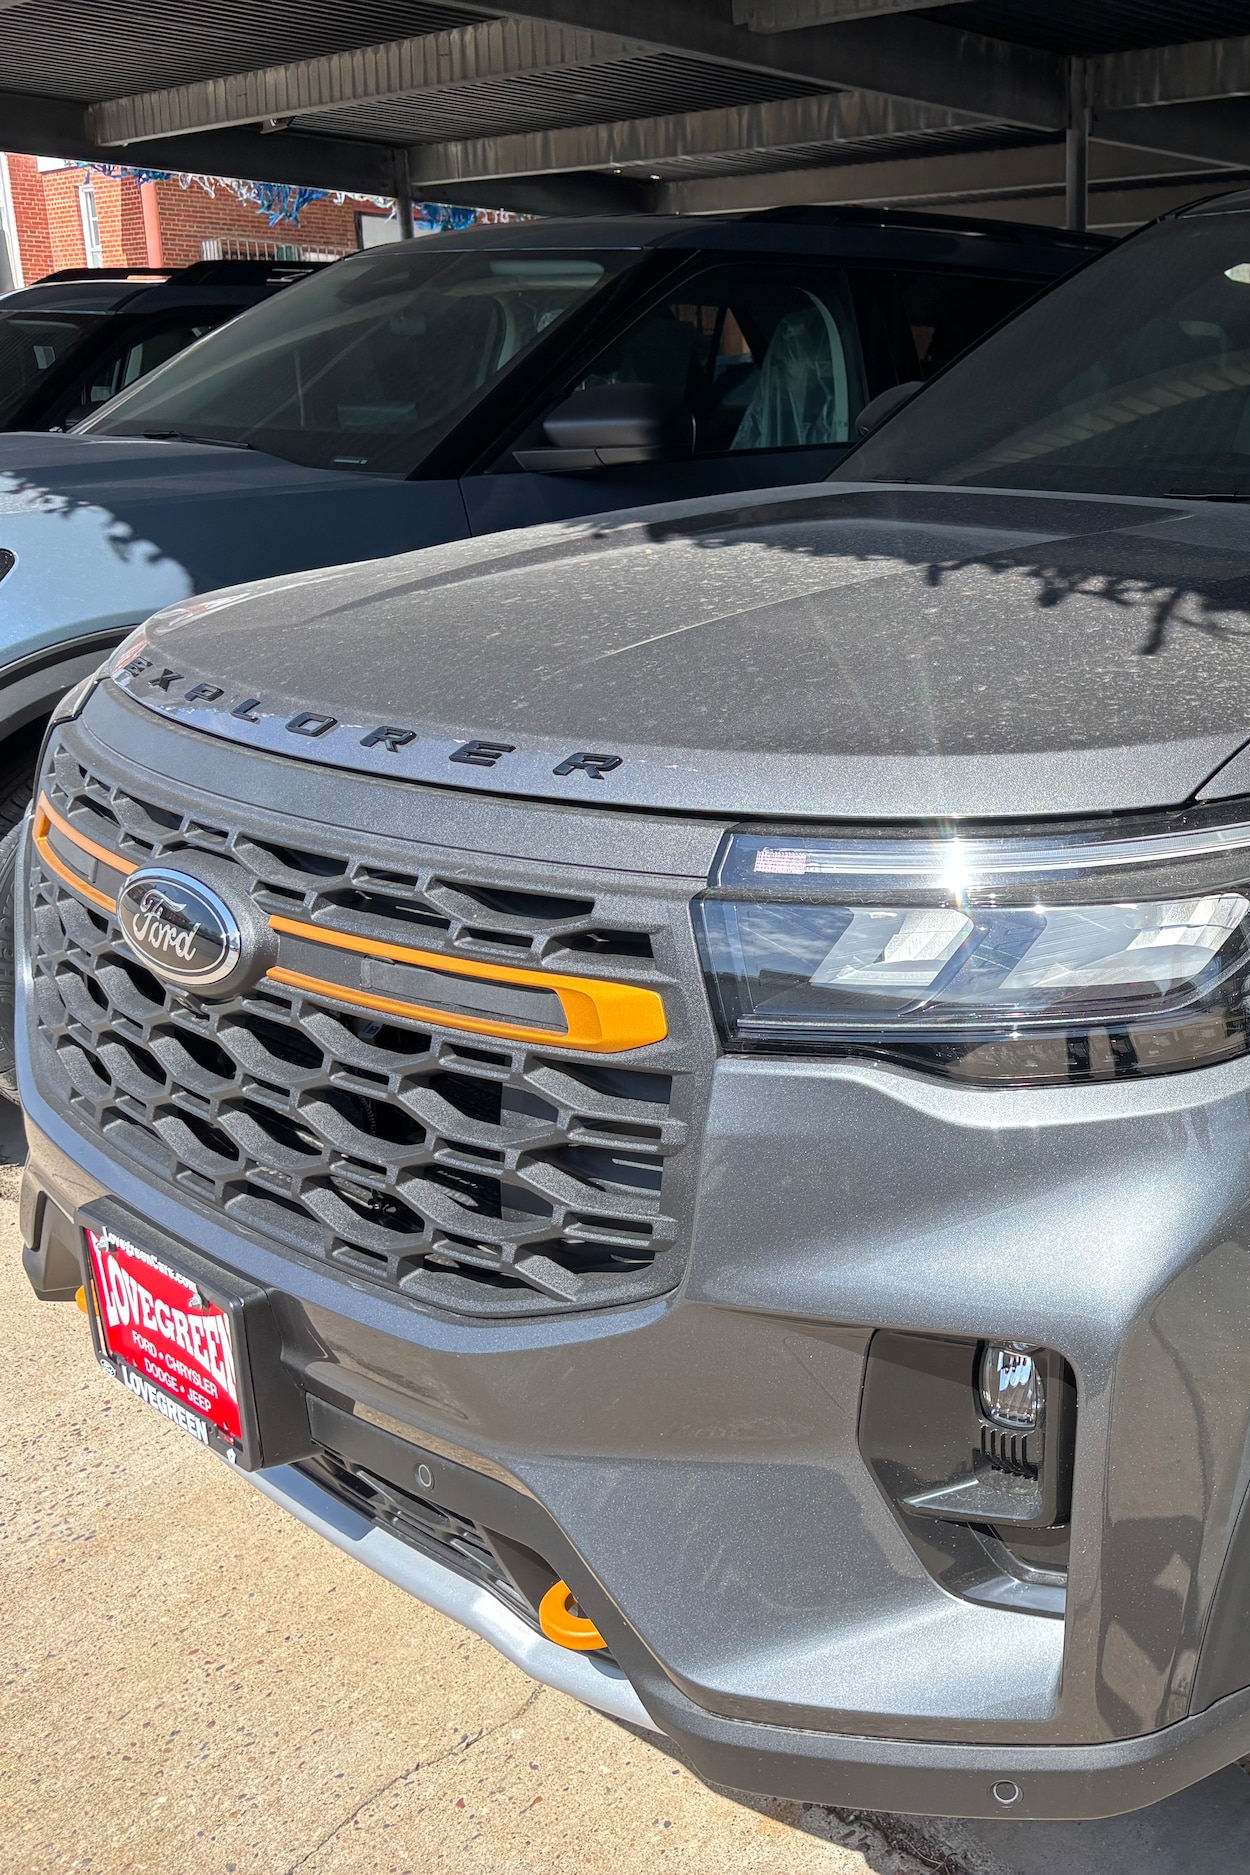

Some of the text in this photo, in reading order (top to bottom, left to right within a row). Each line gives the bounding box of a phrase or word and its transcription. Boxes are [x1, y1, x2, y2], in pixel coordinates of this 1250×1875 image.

[124, 656, 622, 780] EXPLORER
[132, 888, 201, 961] Ford
[91, 1231, 238, 1404] LOVEGREEN
[132, 1330, 219, 1399] FORD CHRYSLER
[144, 1358, 179, 1393] DODGE
[187, 1388, 212, 1413] JEEP
[121, 1364, 209, 1445] LOVEGREEN
